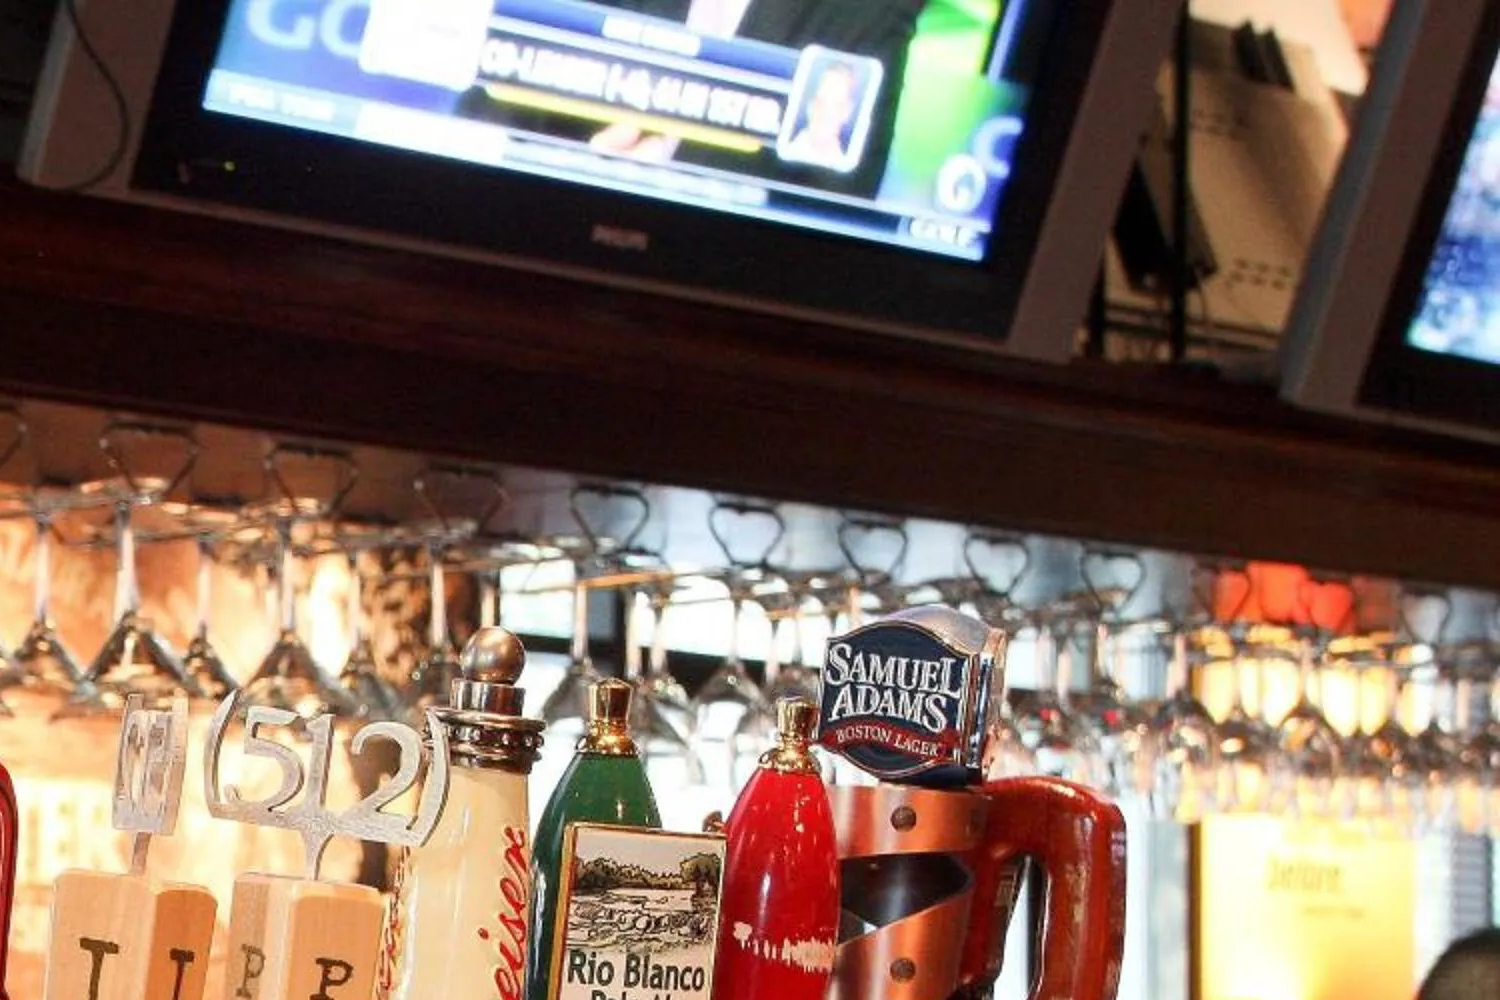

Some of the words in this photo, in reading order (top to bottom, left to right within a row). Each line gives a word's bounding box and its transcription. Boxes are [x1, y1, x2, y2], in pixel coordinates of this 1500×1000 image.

[825, 642, 962, 700] SAMUEL
[828, 683, 948, 733] ADAMS
[835, 724, 893, 744] BOSTON
[894, 733, 939, 757] LAGER
[567, 949, 615, 986] Rio
[623, 953, 706, 992] Blanco
